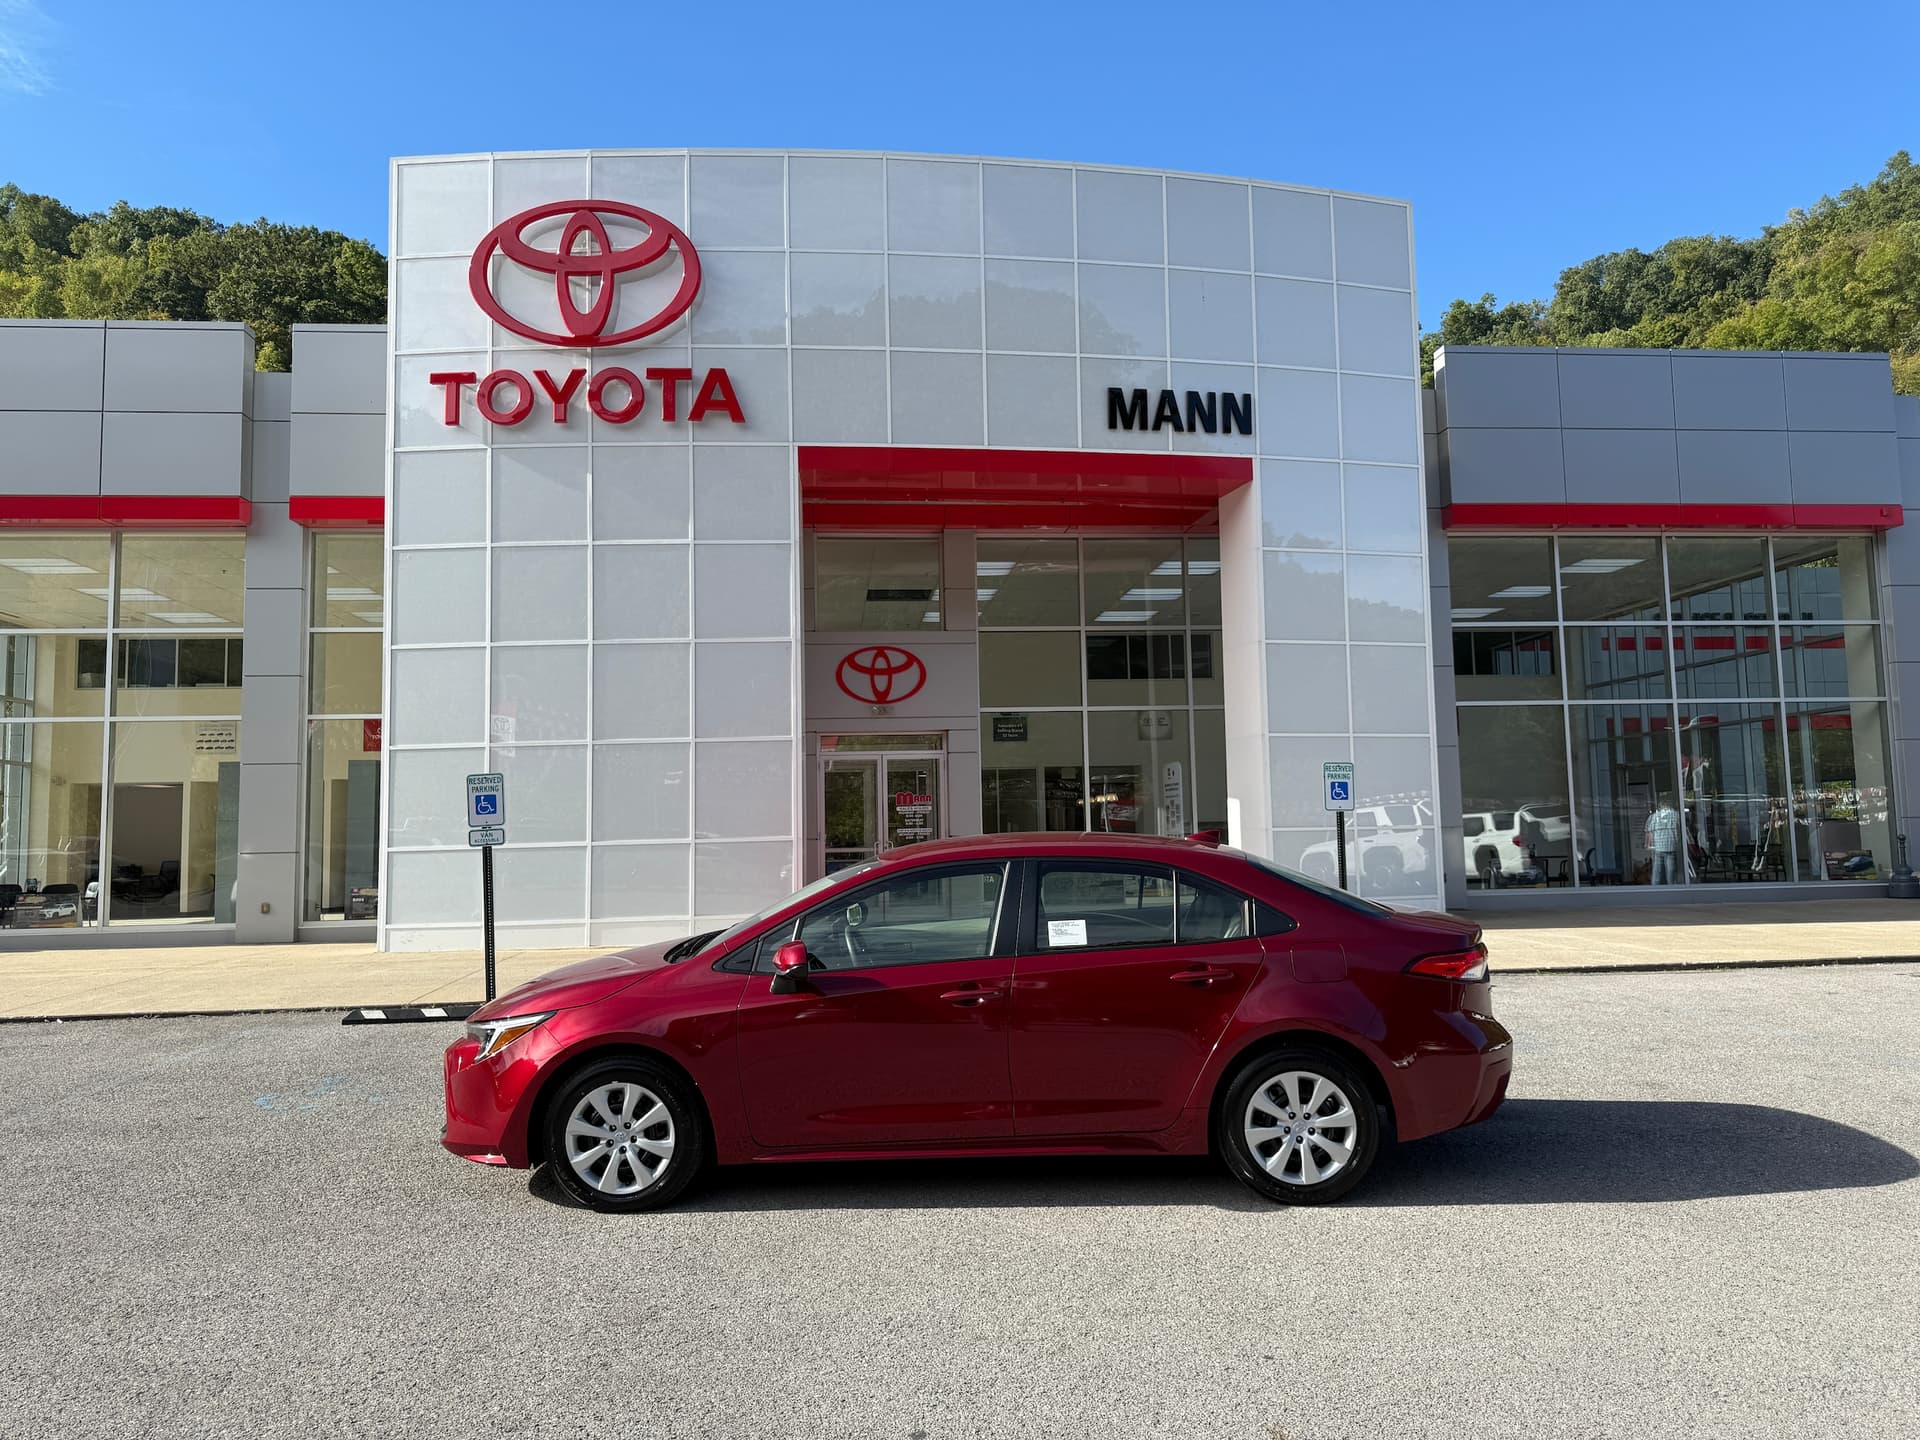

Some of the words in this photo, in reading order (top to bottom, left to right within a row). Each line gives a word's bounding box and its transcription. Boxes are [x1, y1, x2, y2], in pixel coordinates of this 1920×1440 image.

[429, 366, 746, 427] TOYOTA
[1107, 387, 1253, 436] MANN
[1325, 765, 1352, 773] RESERVED
[1327, 772, 1351, 780] PARKING
[468, 776, 502, 785] RESERVED
[471, 785, 500, 793] PARKING
